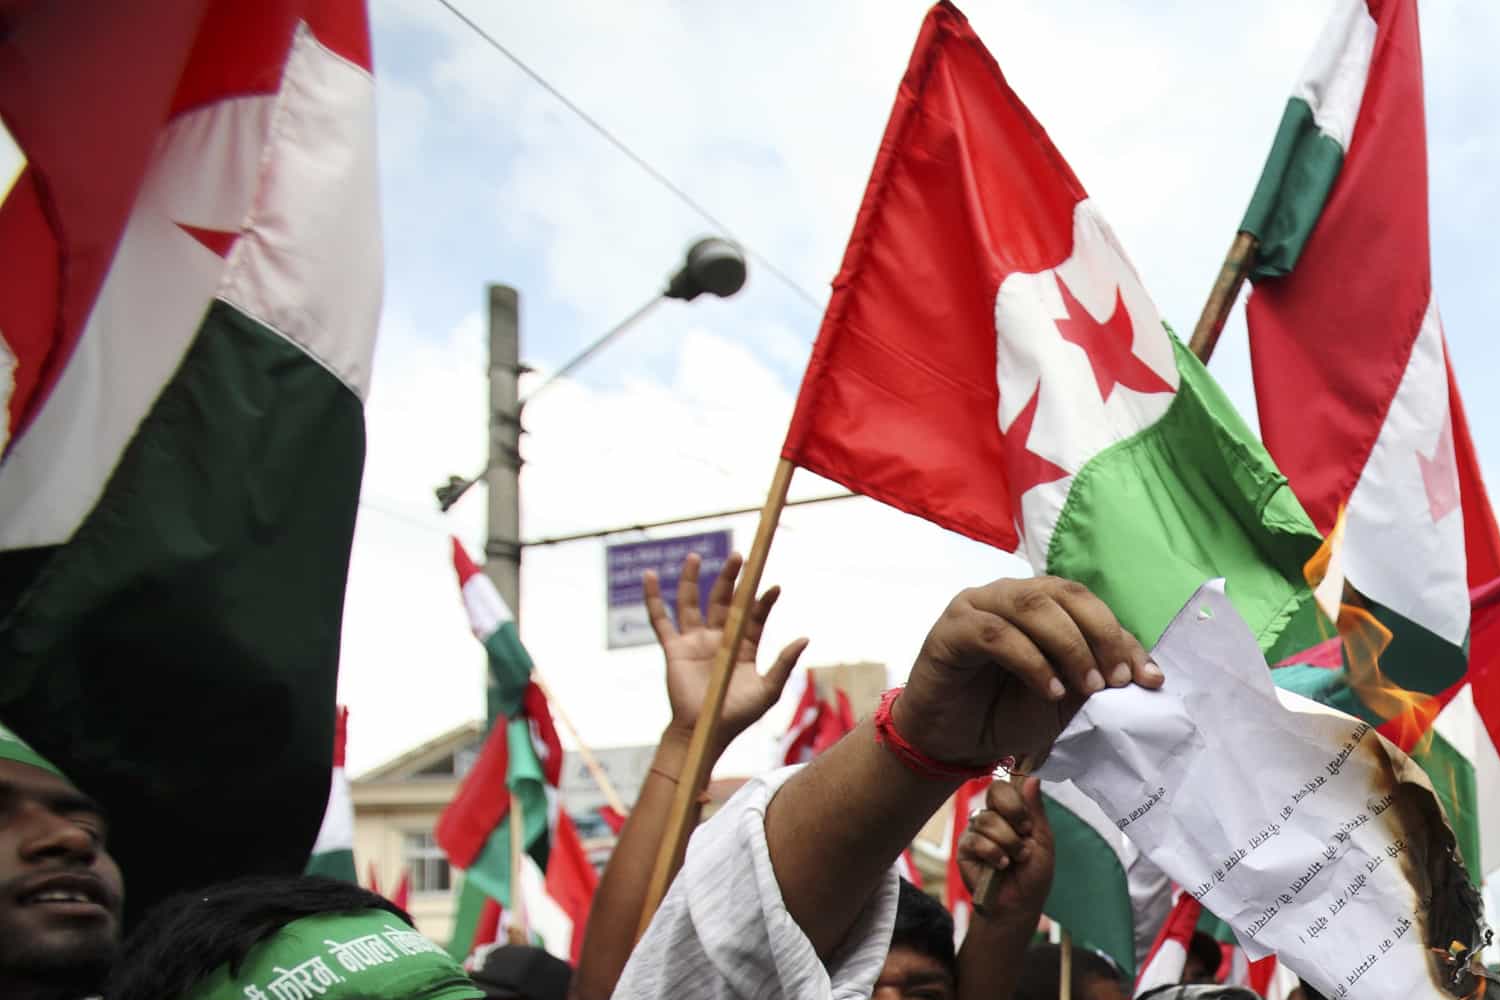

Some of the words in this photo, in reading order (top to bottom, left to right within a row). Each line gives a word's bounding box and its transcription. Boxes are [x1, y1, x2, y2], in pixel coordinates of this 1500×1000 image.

[1280, 806, 1293, 821] का
[1249, 824, 1280, 849] फैसला
[324, 932, 399, 973] नेपाल
[1379, 939, 1394, 954] का
